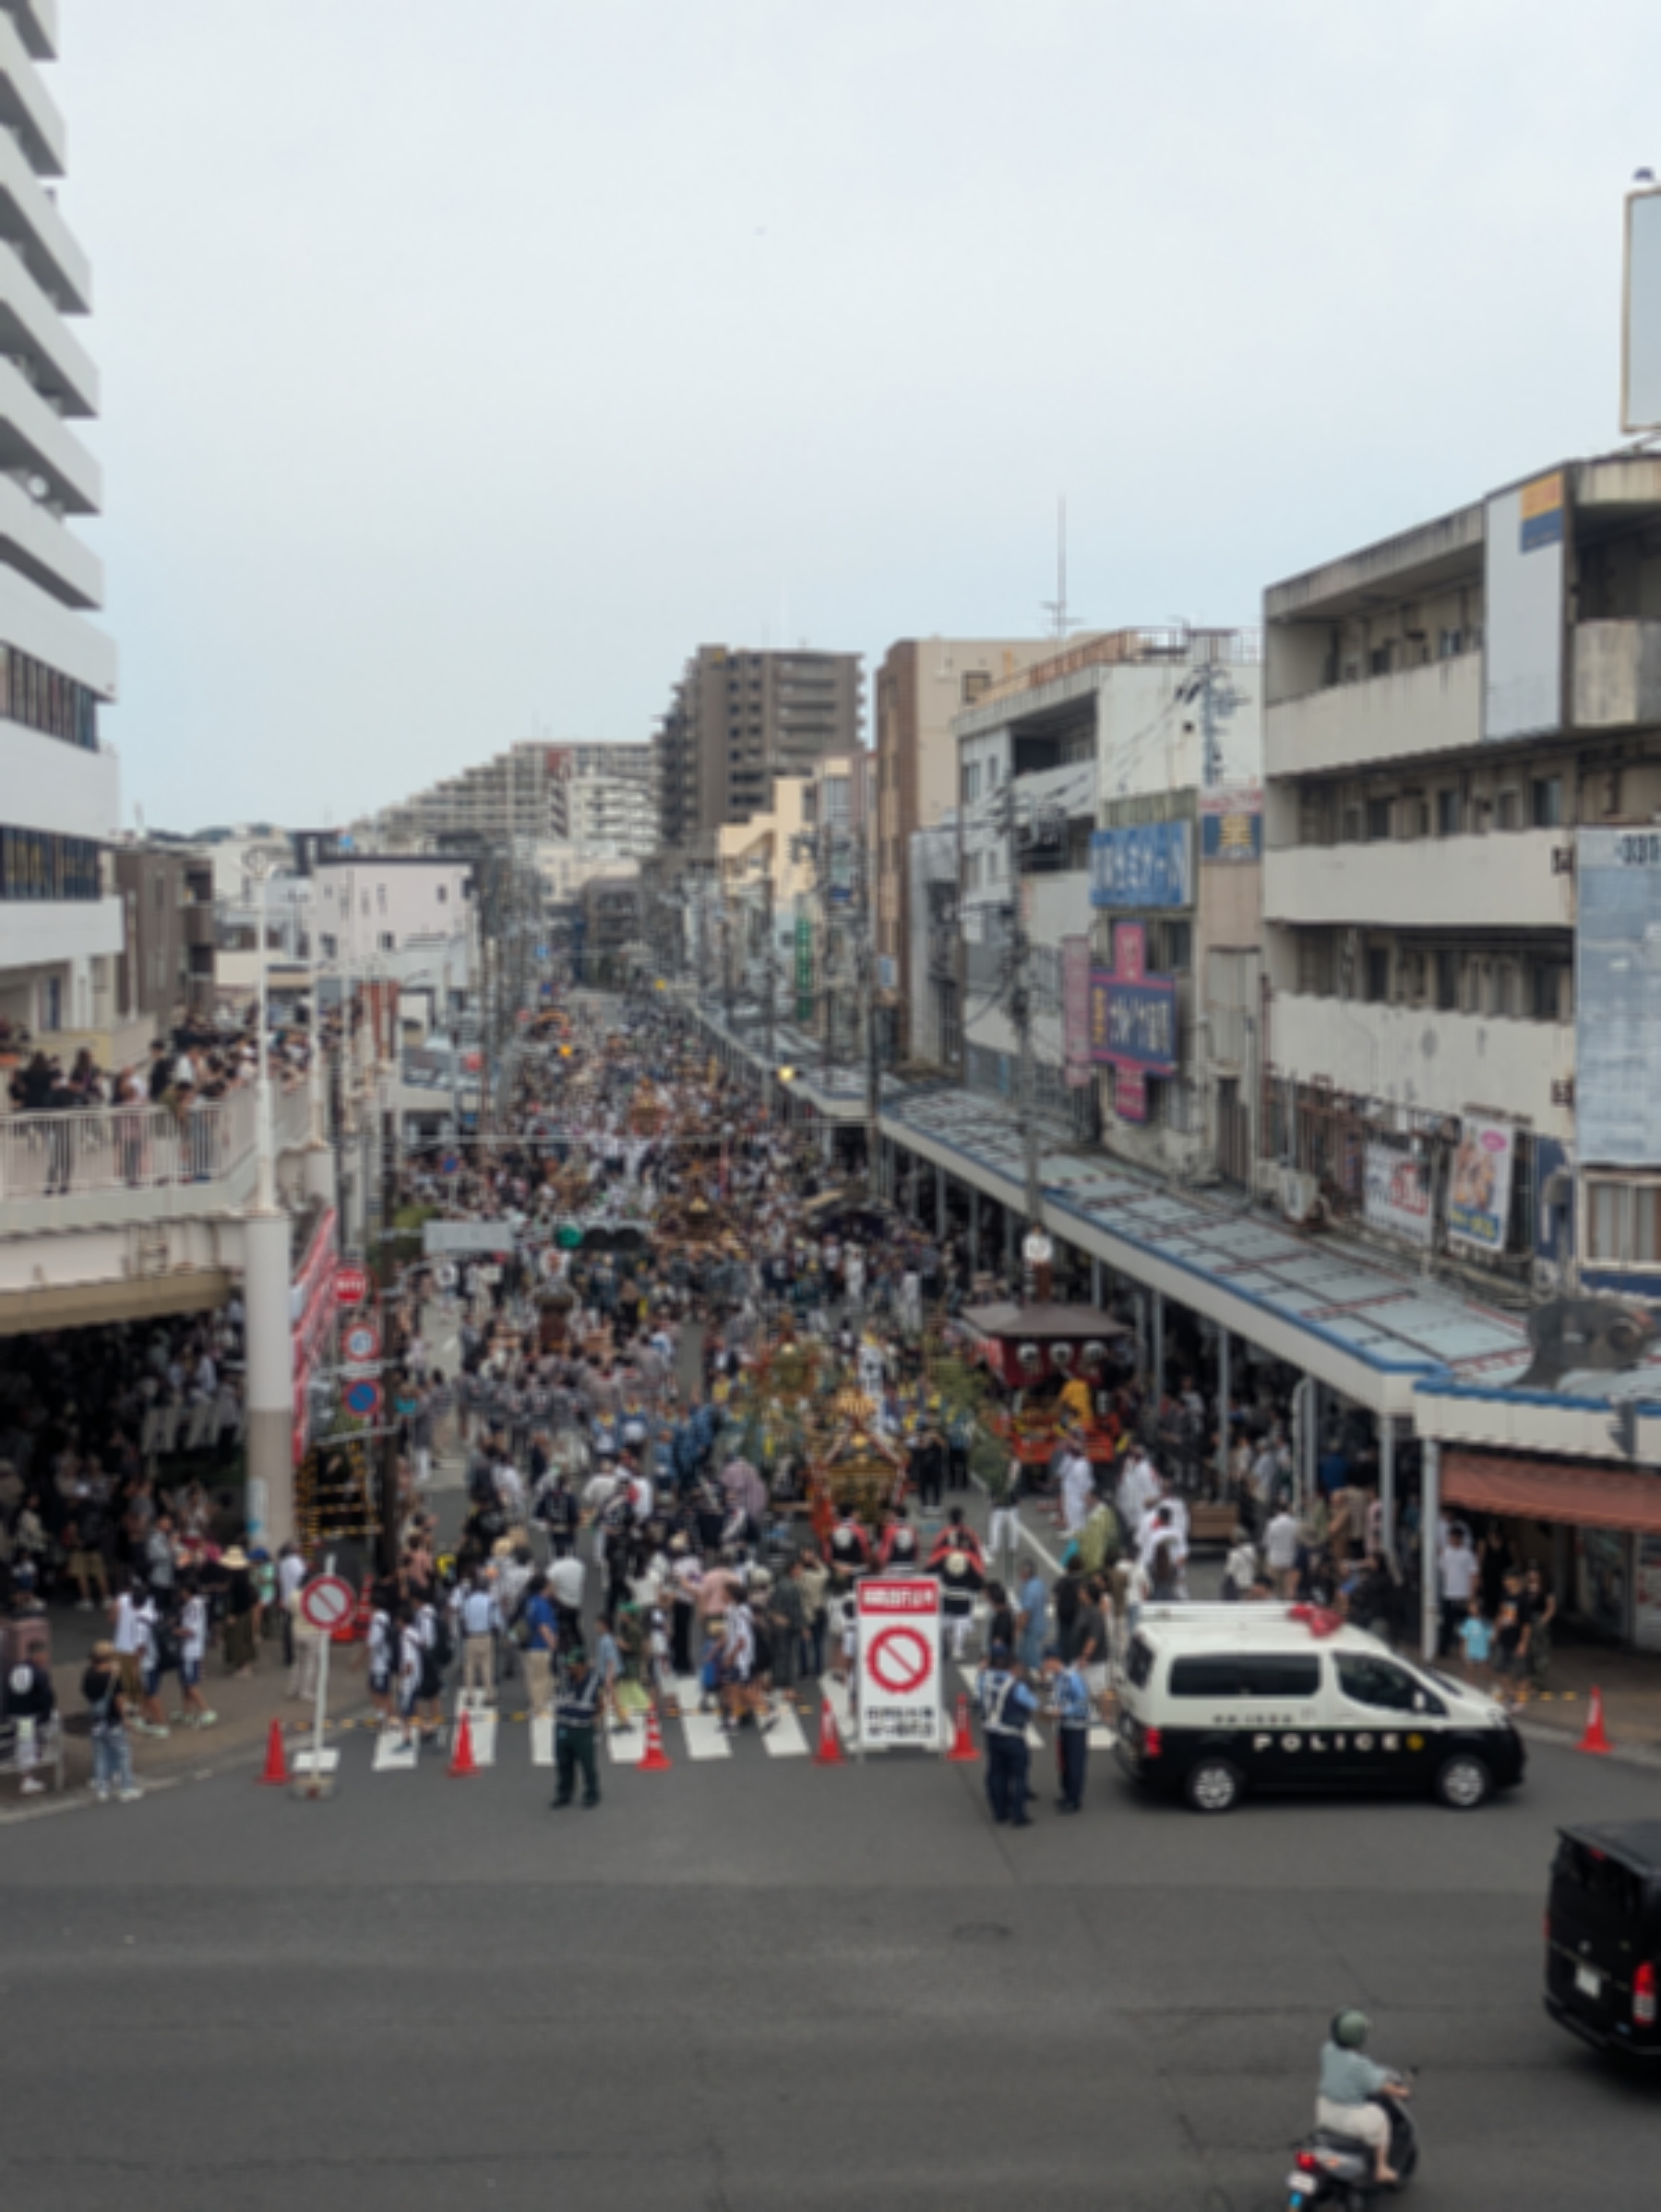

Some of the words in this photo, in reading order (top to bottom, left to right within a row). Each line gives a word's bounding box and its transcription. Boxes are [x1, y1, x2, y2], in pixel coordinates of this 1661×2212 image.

[1091, 842, 1186, 889] ゼミナール
[1253, 1732, 1399, 1752] POLICE
